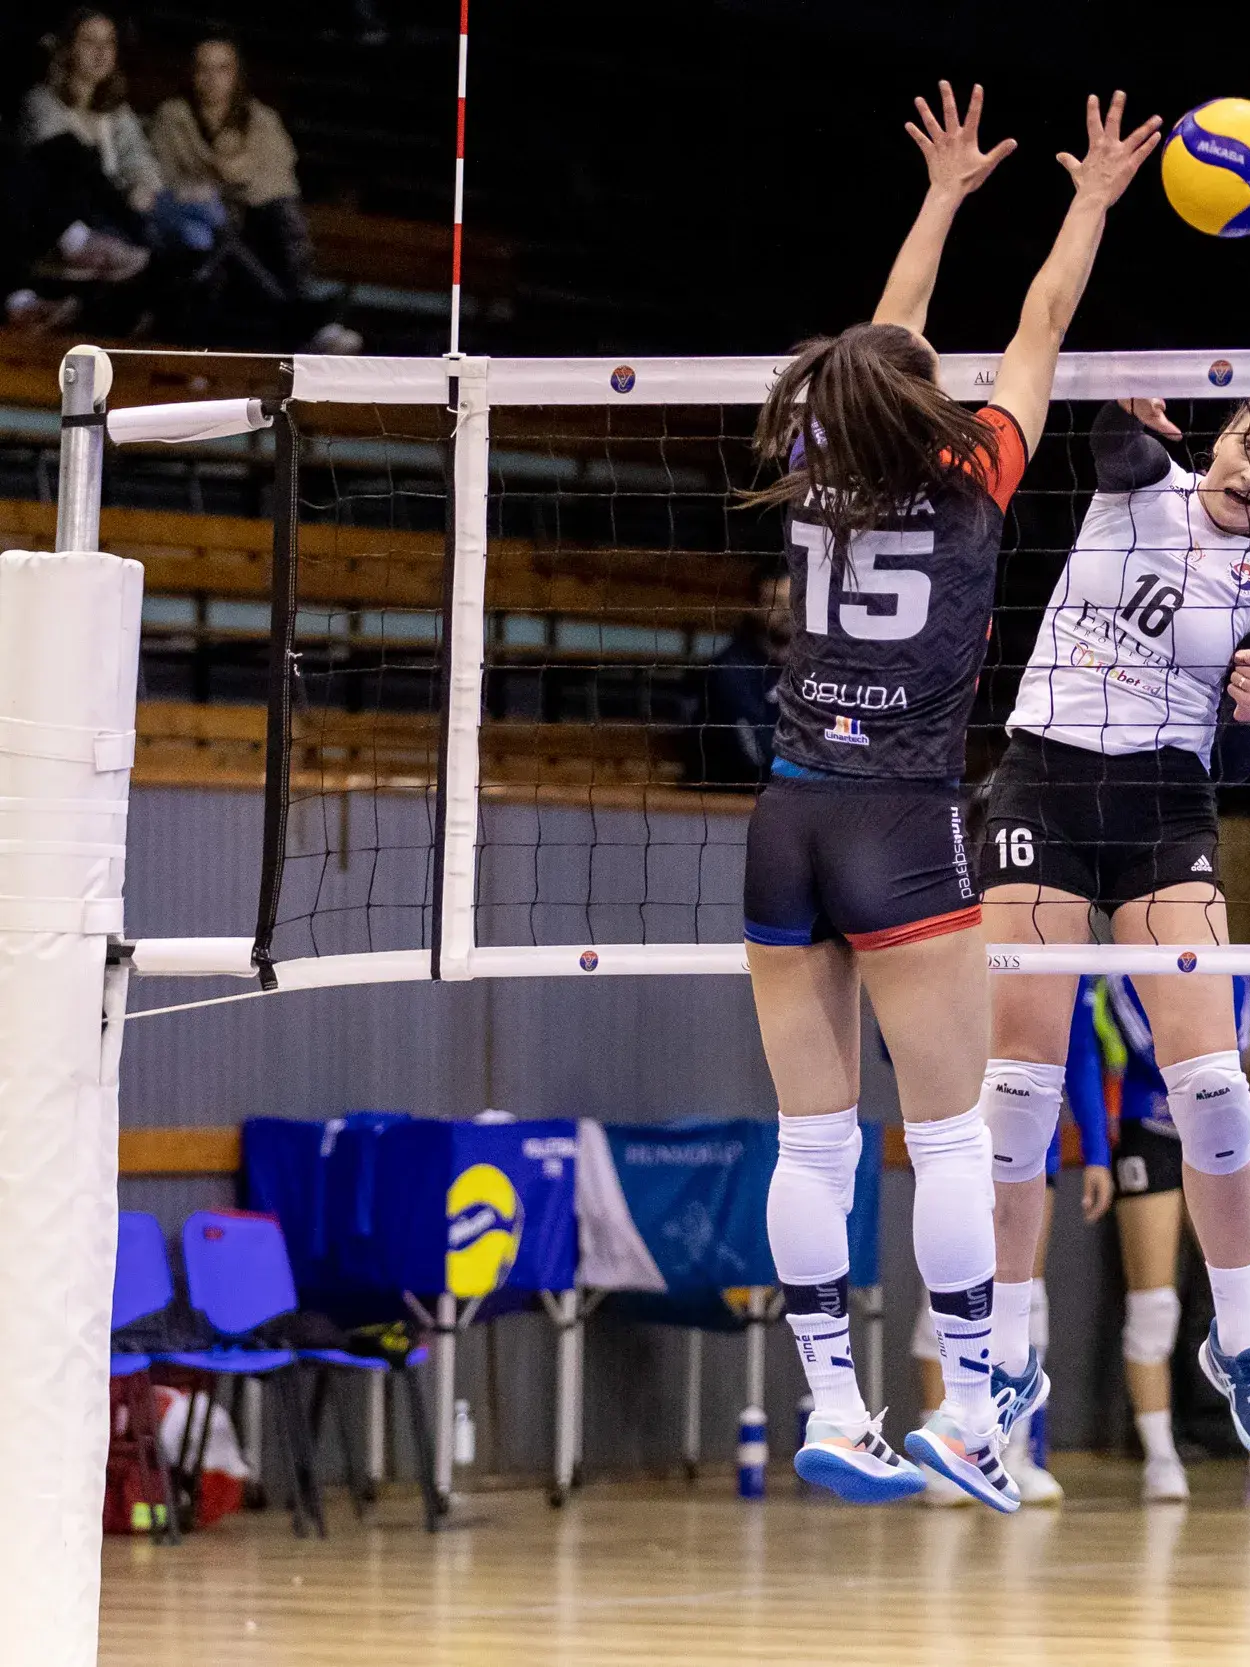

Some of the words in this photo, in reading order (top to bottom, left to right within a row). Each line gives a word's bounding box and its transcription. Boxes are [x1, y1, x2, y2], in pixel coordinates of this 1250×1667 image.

[791, 520, 935, 640] 15
[1121, 574, 1184, 638] 16
[802, 672, 908, 709] ÓBUDA
[826, 730, 869, 744] Linartech
[995, 827, 1035, 870] 16
[800, 1334, 817, 1363] nine
[936, 1329, 948, 1358] nine
